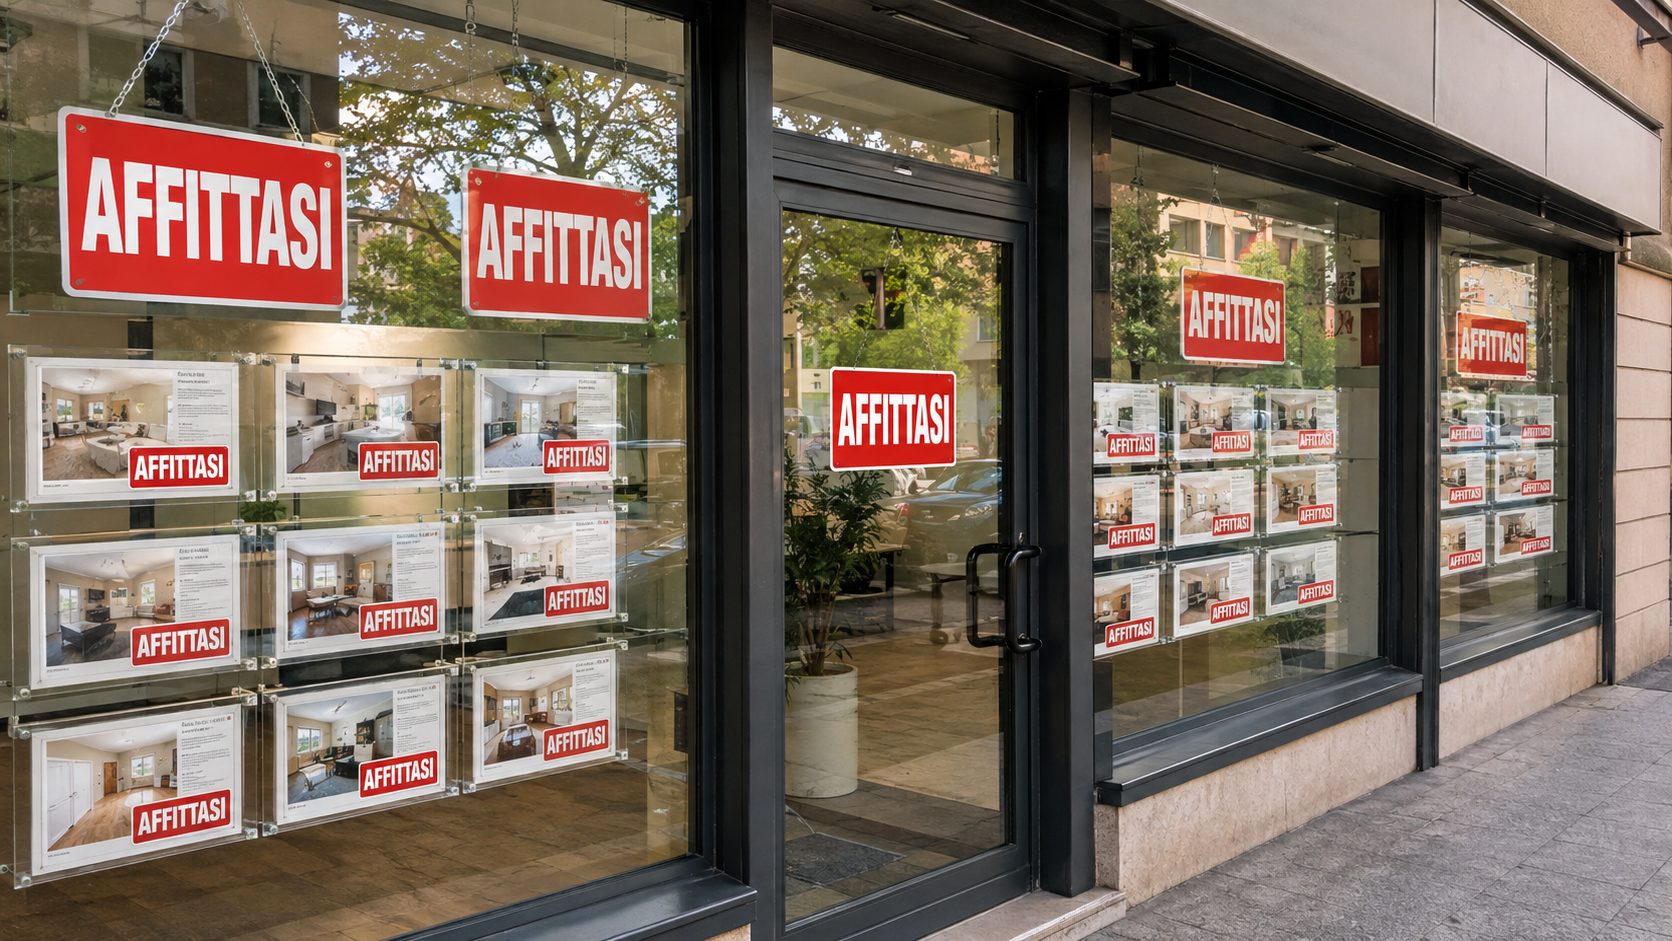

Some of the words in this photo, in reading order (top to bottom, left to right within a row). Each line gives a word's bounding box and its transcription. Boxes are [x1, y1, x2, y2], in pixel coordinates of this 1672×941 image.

[81, 157, 331, 269] AFFITTASI
[477, 203, 642, 290] AFFITTASI
[1189, 290, 1280, 344] AFFITTASI
[1461, 327, 1524, 364] AFFITTASI
[838, 393, 949, 446] AFFITTASI
[547, 446, 606, 467] AFFITTASI
[1110, 436, 1153, 454] AFFITTASI
[134, 454, 223, 480] AFFITTASI
[363, 449, 434, 473] AFFITTASI
[1111, 527, 1152, 545] AFFITTASI
[1214, 516, 1249, 533] AFFITTASI
[548, 586, 605, 611] AFFITTASI
[1212, 601, 1248, 620] AFFITTASI
[364, 605, 434, 632] AFFITTASI
[1108, 620, 1152, 643] AFFITTASI
[137, 626, 225, 658] AFFITTASI
[547, 726, 605, 754] AFFITTASI
[364, 758, 434, 791] AFFITTASI
[138, 797, 226, 836] AFFITTASI
